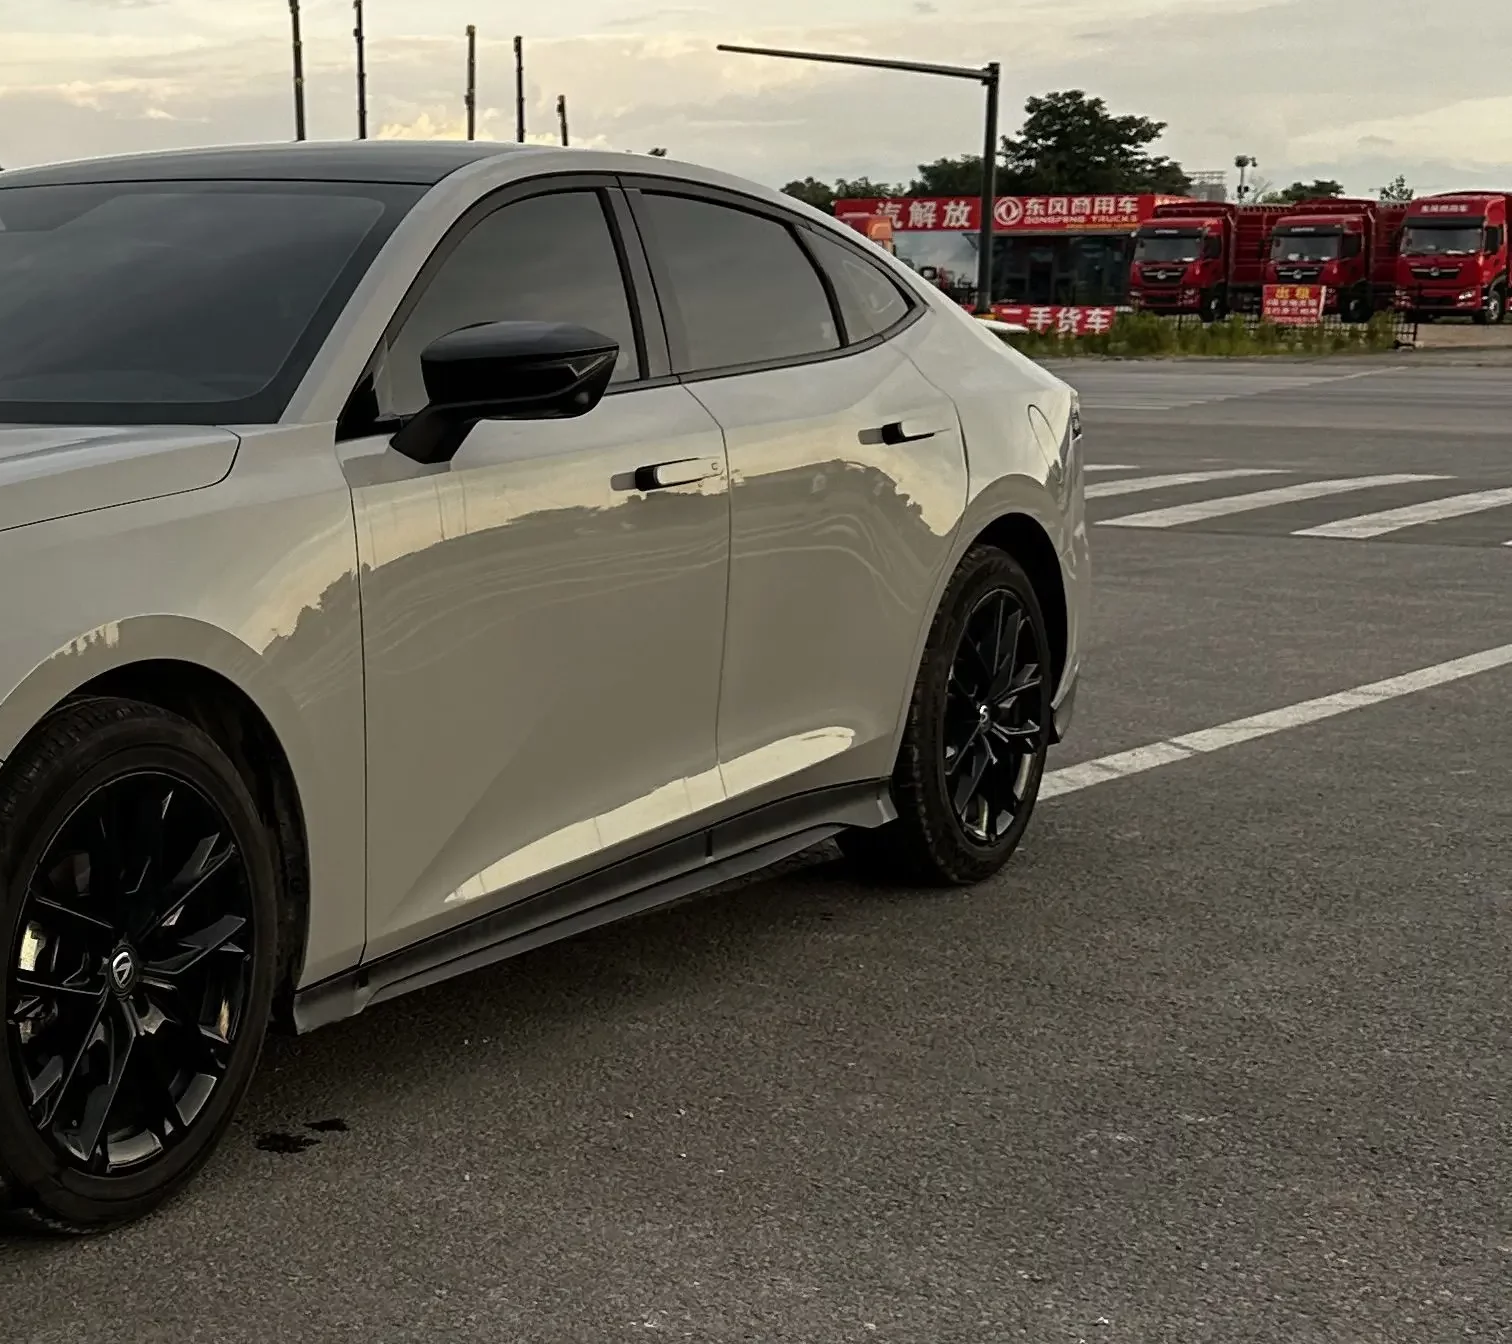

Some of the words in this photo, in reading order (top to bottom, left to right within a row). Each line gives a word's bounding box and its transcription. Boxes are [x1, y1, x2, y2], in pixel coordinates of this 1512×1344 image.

[842, 200, 974, 229] 一汽解放
[1023, 197, 1139, 215] 东风商用车
